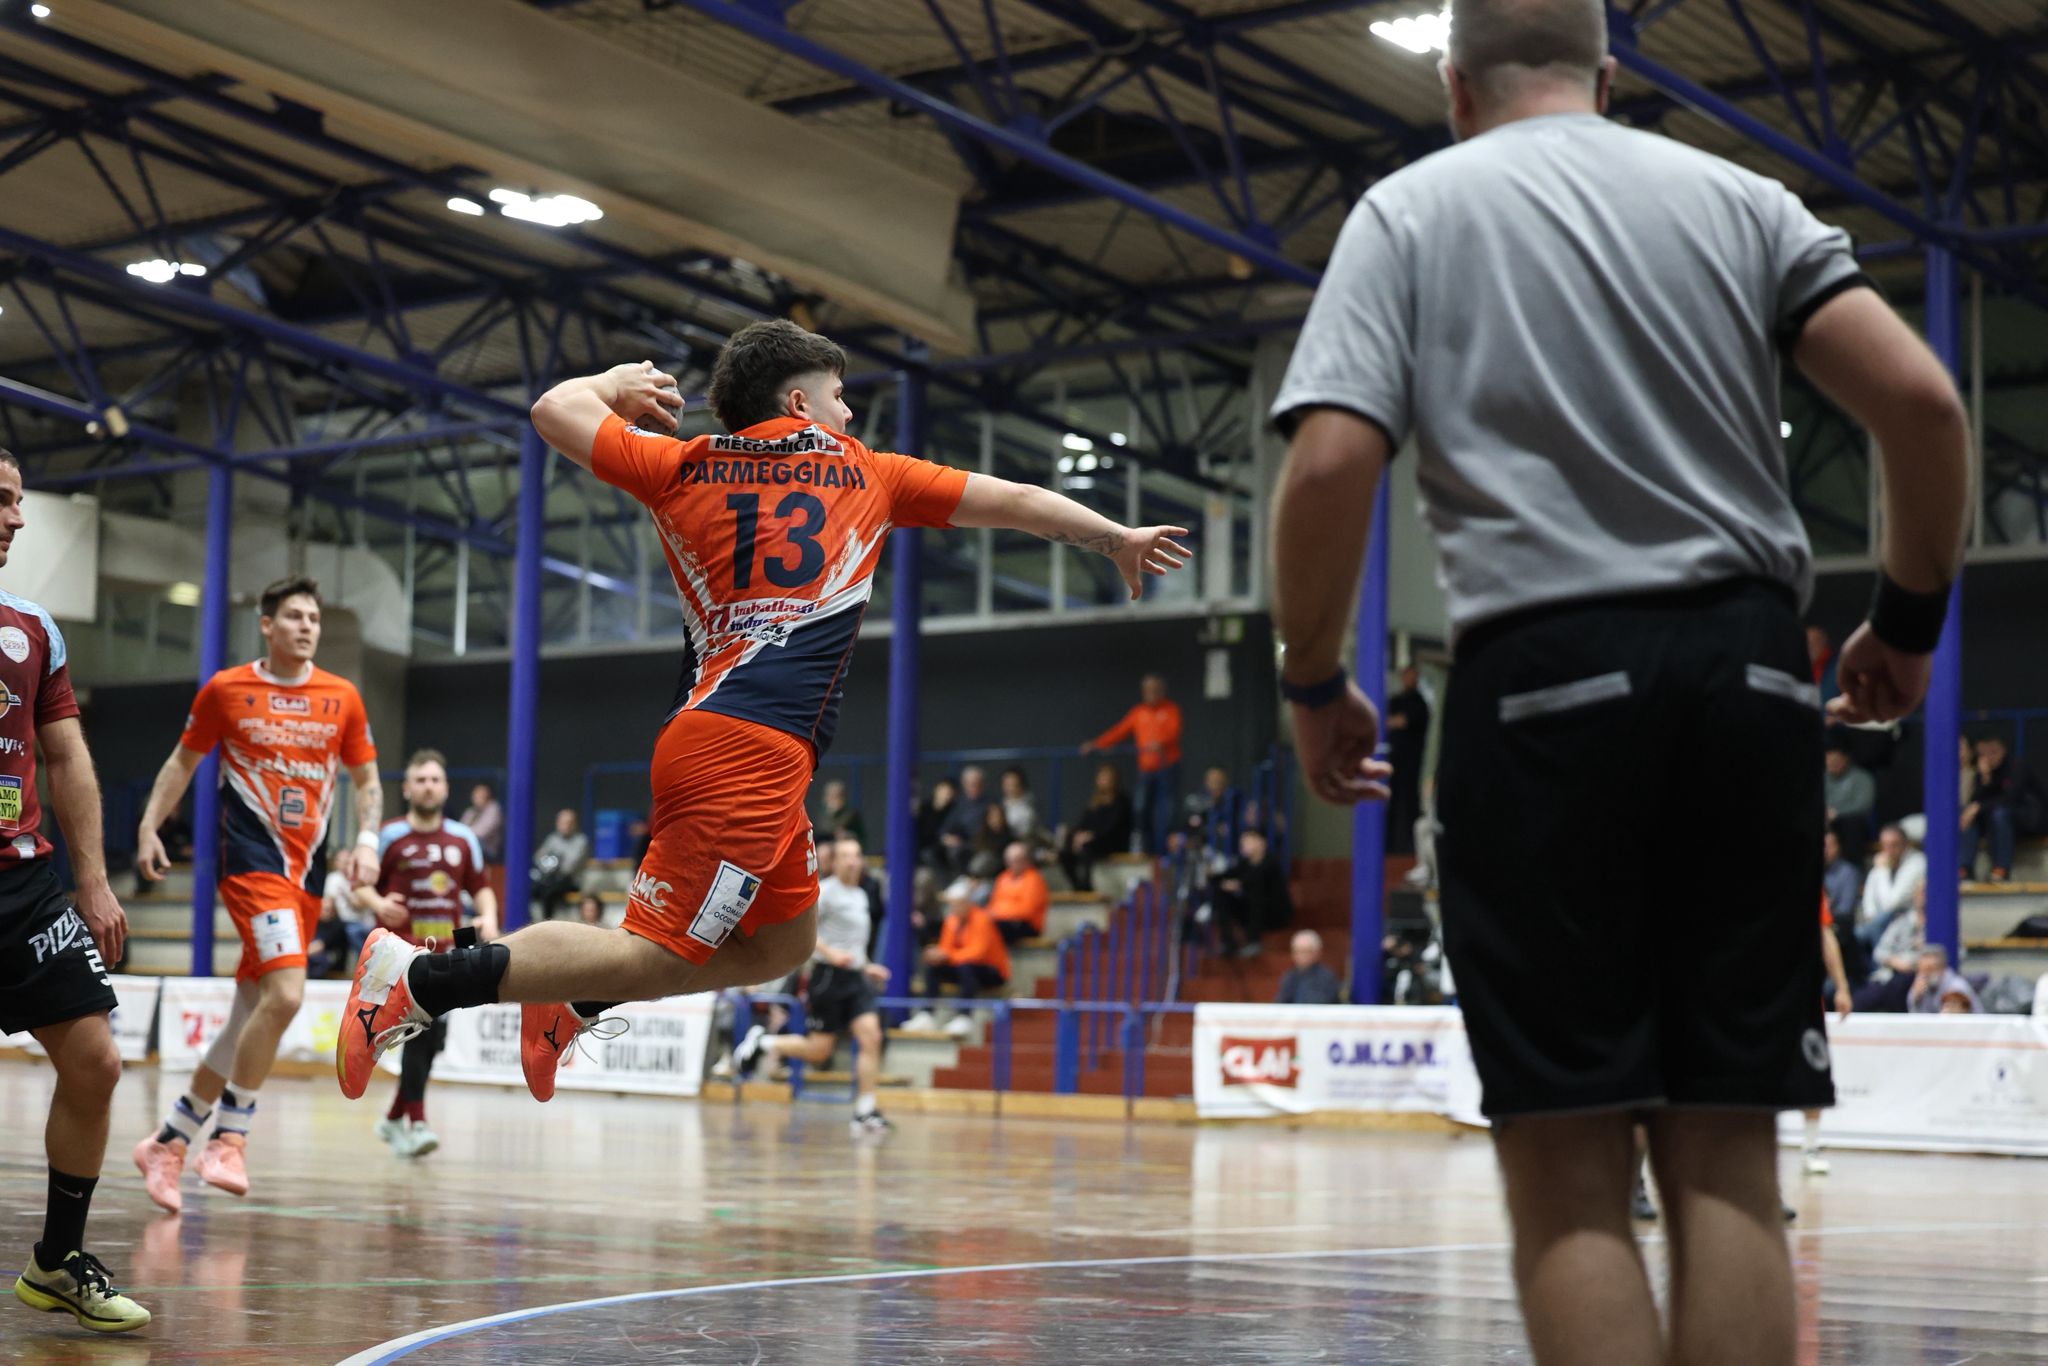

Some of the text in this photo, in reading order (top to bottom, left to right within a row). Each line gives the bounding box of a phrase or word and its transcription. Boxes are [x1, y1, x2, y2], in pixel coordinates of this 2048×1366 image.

[715, 434, 815, 453] MECCANICA
[725, 491, 827, 590] 13
[322, 697, 341, 715] 77
[1221, 1044, 1292, 1080] CLAI
